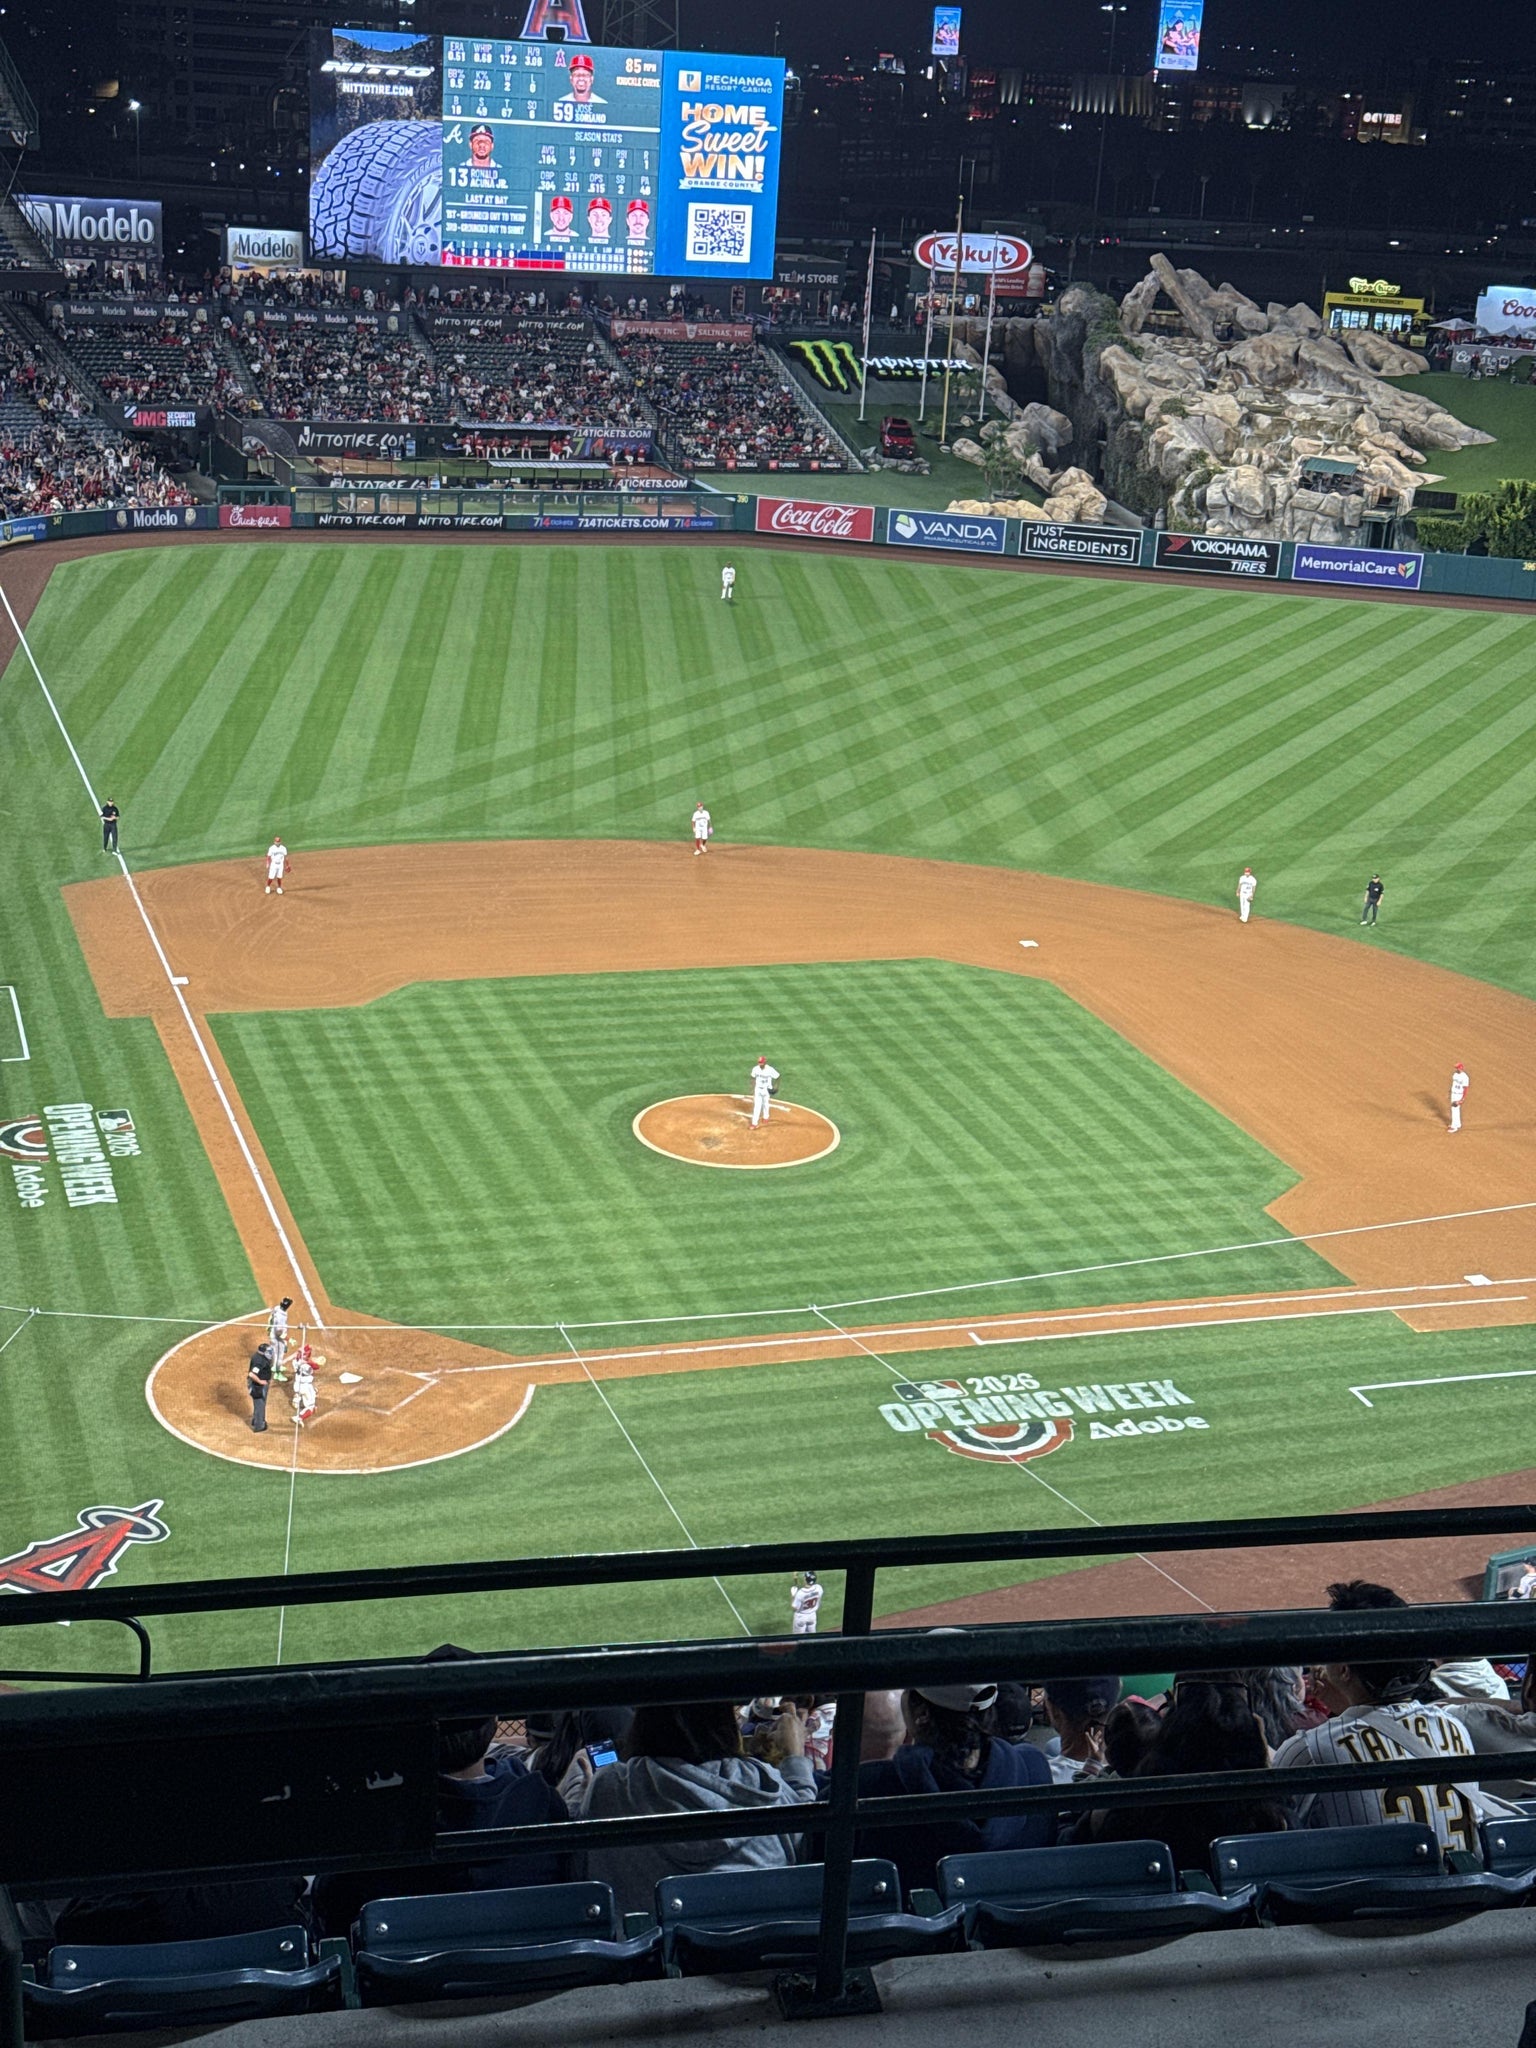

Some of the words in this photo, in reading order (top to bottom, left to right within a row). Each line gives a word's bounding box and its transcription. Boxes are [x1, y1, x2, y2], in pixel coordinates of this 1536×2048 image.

[450, 41, 464, 51] ERA
[473, 43, 492, 53] WHIP
[504, 45, 512, 54] IP
[500, 54, 517, 65] 17.2
[625, 57, 642, 74] 85
[320, 60, 433, 77] NITTO
[448, 69, 465, 79] BB%
[476, 70, 489, 81] K%
[504, 72, 512, 82] W
[530, 73, 536, 84] L
[704, 74, 773, 87] PECHANGA
[342, 82, 414, 97] NITTOTIRE.COM
[473, 80, 492, 90] 27.0
[504, 82, 511, 92] 2
[529, 83, 536, 93] 0
[704, 84, 737, 92] RESORT
[741, 86, 773, 94] CASINO
[479, 97, 484, 107] S
[504, 98, 510, 108] T
[527, 100, 537, 110] SO
[501, 108, 513, 118] 67
[553, 101, 574, 122] 59
[681, 101, 767, 125] HOME
[574, 131, 601, 142] SEASON
[602, 132, 623, 143] STATS
[680, 120, 778, 153] Sweet
[541, 145, 555, 155] AVG
[569, 146, 575, 157] H
[592, 148, 602, 158] HR
[615, 149, 627, 159] RBI
[643, 150, 649, 160] R
[569, 156, 576, 166] 7
[618, 158, 625, 168] 2
[680, 151, 765, 181] WIN!
[448, 167, 468, 187] 13
[470, 169, 498, 179] RONALD
[540, 170, 555, 181] OBP
[564, 172, 578, 182] SLG
[589, 173, 603, 183] OPS
[615, 174, 626, 184] SB
[641, 176, 650, 186] PA
[563, 182, 580, 192] .211
[617, 184, 624, 194] 2
[465, 193, 484, 204] LAST
[484, 194, 494, 204] AT
[494, 195, 509, 205] BAT
[55, 202, 155, 244] Modelo
[238, 233, 294, 258] Modelo
[779, 270, 806, 283] TEAM
[807, 273, 839, 284] STORE
[70, 305, 95, 315] Modelo
[102, 306, 126, 316] Modelo
[133, 306, 157, 317] Modelo
[164, 307, 188, 318] Modelo
[1503, 299, 1536, 318] Coo
[263, 311, 287, 322] Modelo
[294, 312, 318, 323] Modelo
[325, 313, 348, 324] Modelo
[355, 314, 378, 325] Modelo
[434, 317, 461, 326] NITTO
[463, 318, 502, 327] TIRE.COM
[518, 320, 543, 329] NITTO
[546, 321, 585, 331] TIRE.COM
[663, 327, 680, 336] INC.
[132, 410, 167, 427] JMG
[167, 411, 196, 419] SECURITY
[167, 419, 196, 427] SYSTEMS
[573, 429, 651, 439] 714TICKETS.COM
[736, 494, 749, 504] 390
[133, 509, 178, 527] Modelo
[319, 514, 352, 525] NITTO
[355, 514, 406, 526] TIRE.COM
[418, 515, 451, 525] NITTO
[454, 515, 504, 527] TIRE.COM
[578, 517, 669, 528] 714TICKETS.COM
[771, 501, 859, 536] Coca-Cola
[918, 519, 998, 542] VANDA
[1032, 524, 1065, 538] JUST
[1032, 537, 1128, 557] INGREDIENTS
[1190, 539, 1268, 559] YOKOHAMA
[1230, 561, 1267, 574] TIRES
[1300, 555, 1397, 576] MemorialCare
[43, 1102, 106, 1164] OPENING
[104, 1132, 142, 1157] 2026
[12, 1164, 50, 1208] Adobe
[59, 1161, 119, 1208] WEEK
[965, 1372, 1041, 1395] 2026
[878, 1390, 1075, 1432] OPENING
[1060, 1379, 1196, 1415] WEEK
[1089, 1415, 1210, 1440] Adobe
[802, 1597, 819, 1610] 30
